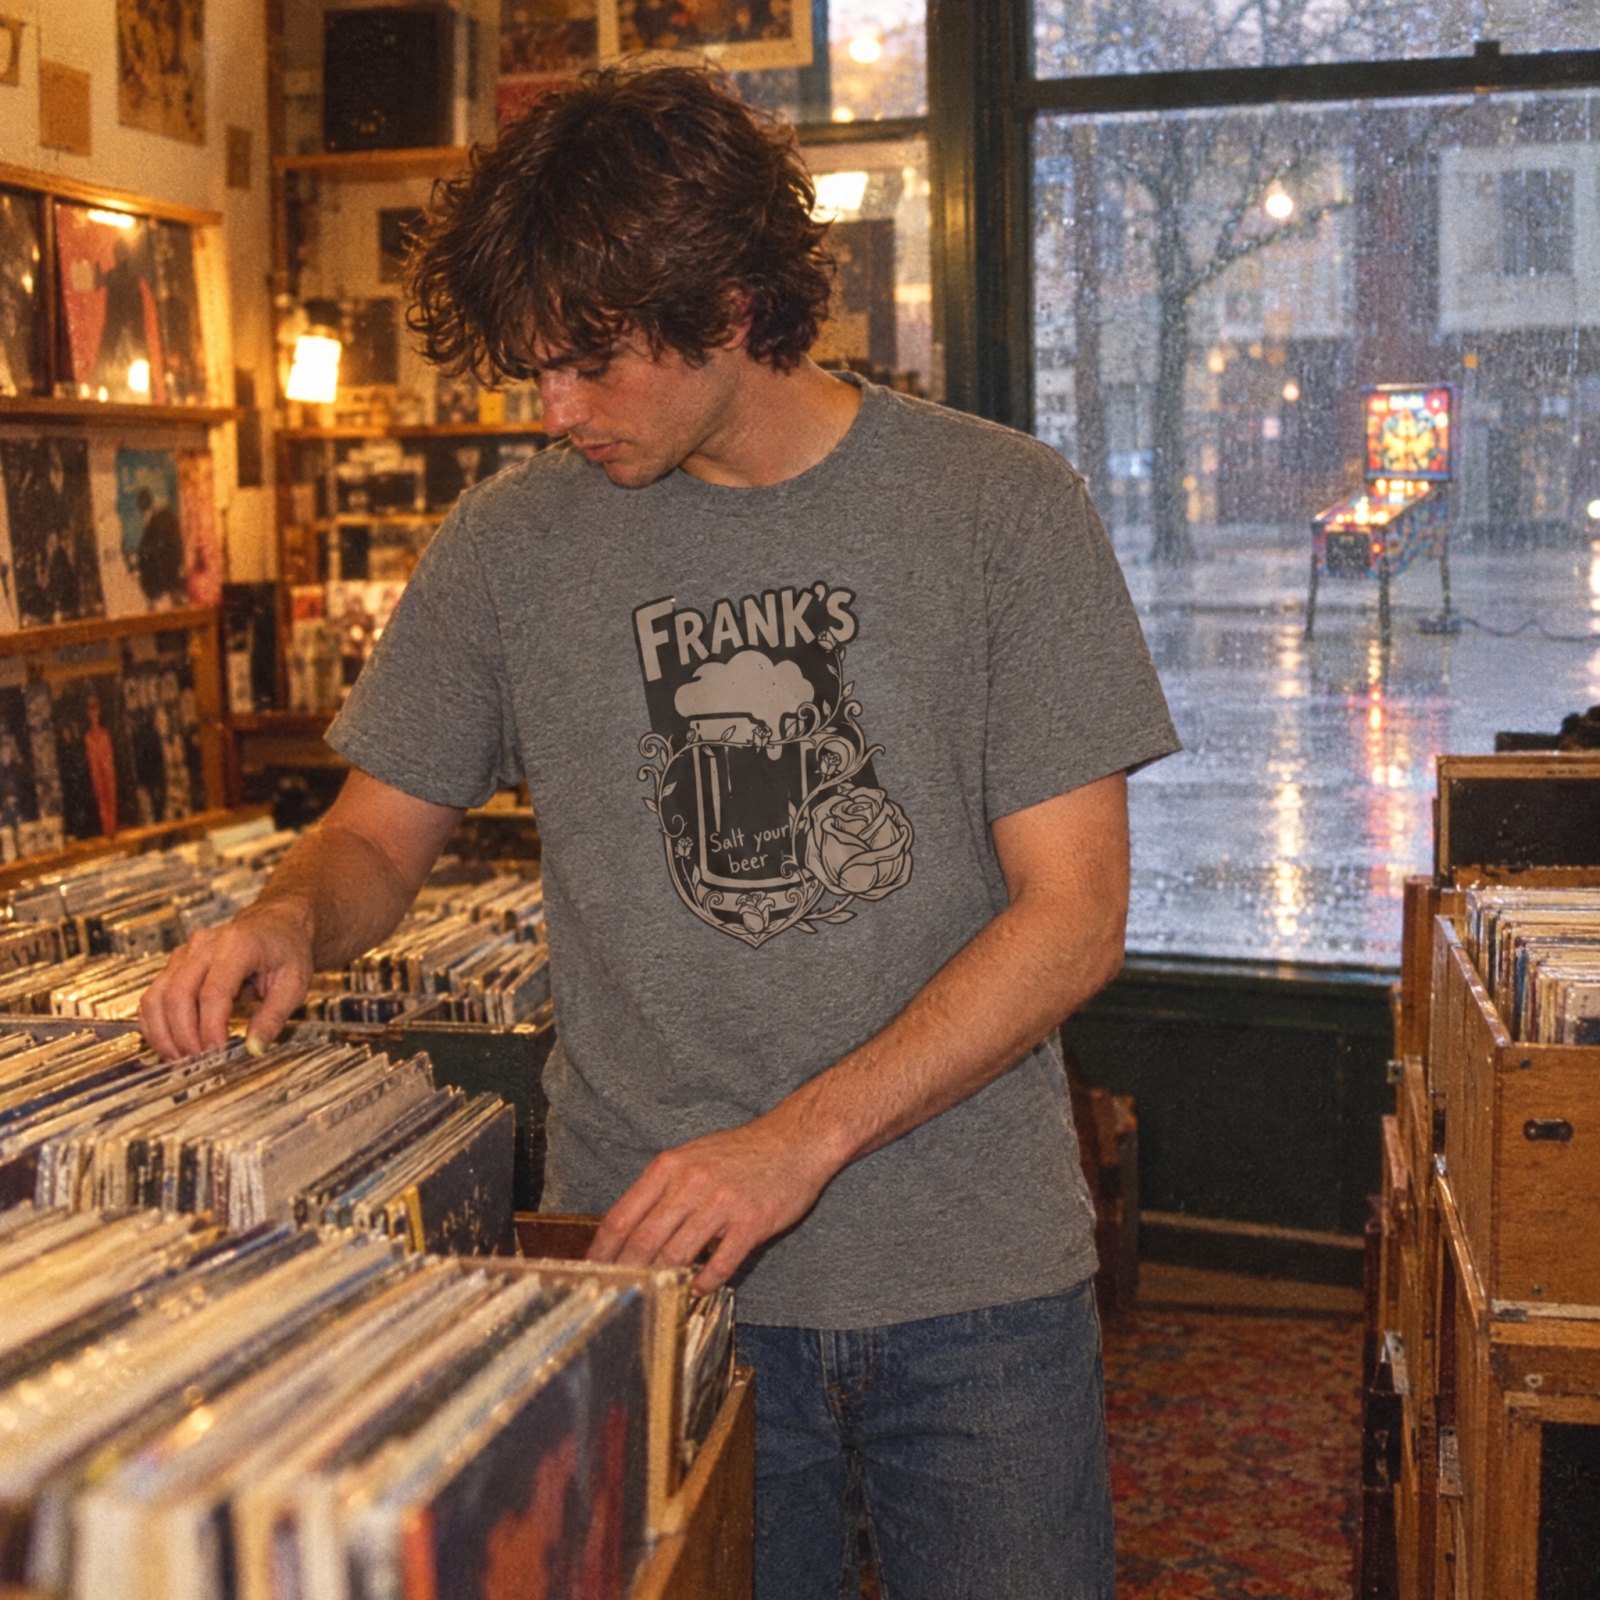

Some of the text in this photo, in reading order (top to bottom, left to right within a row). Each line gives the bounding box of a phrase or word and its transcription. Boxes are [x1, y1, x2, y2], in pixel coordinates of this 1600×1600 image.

[635, 583, 855, 682] FRANK'S
[709, 824, 789, 853] Salt your
[728, 853, 769, 874] beer
